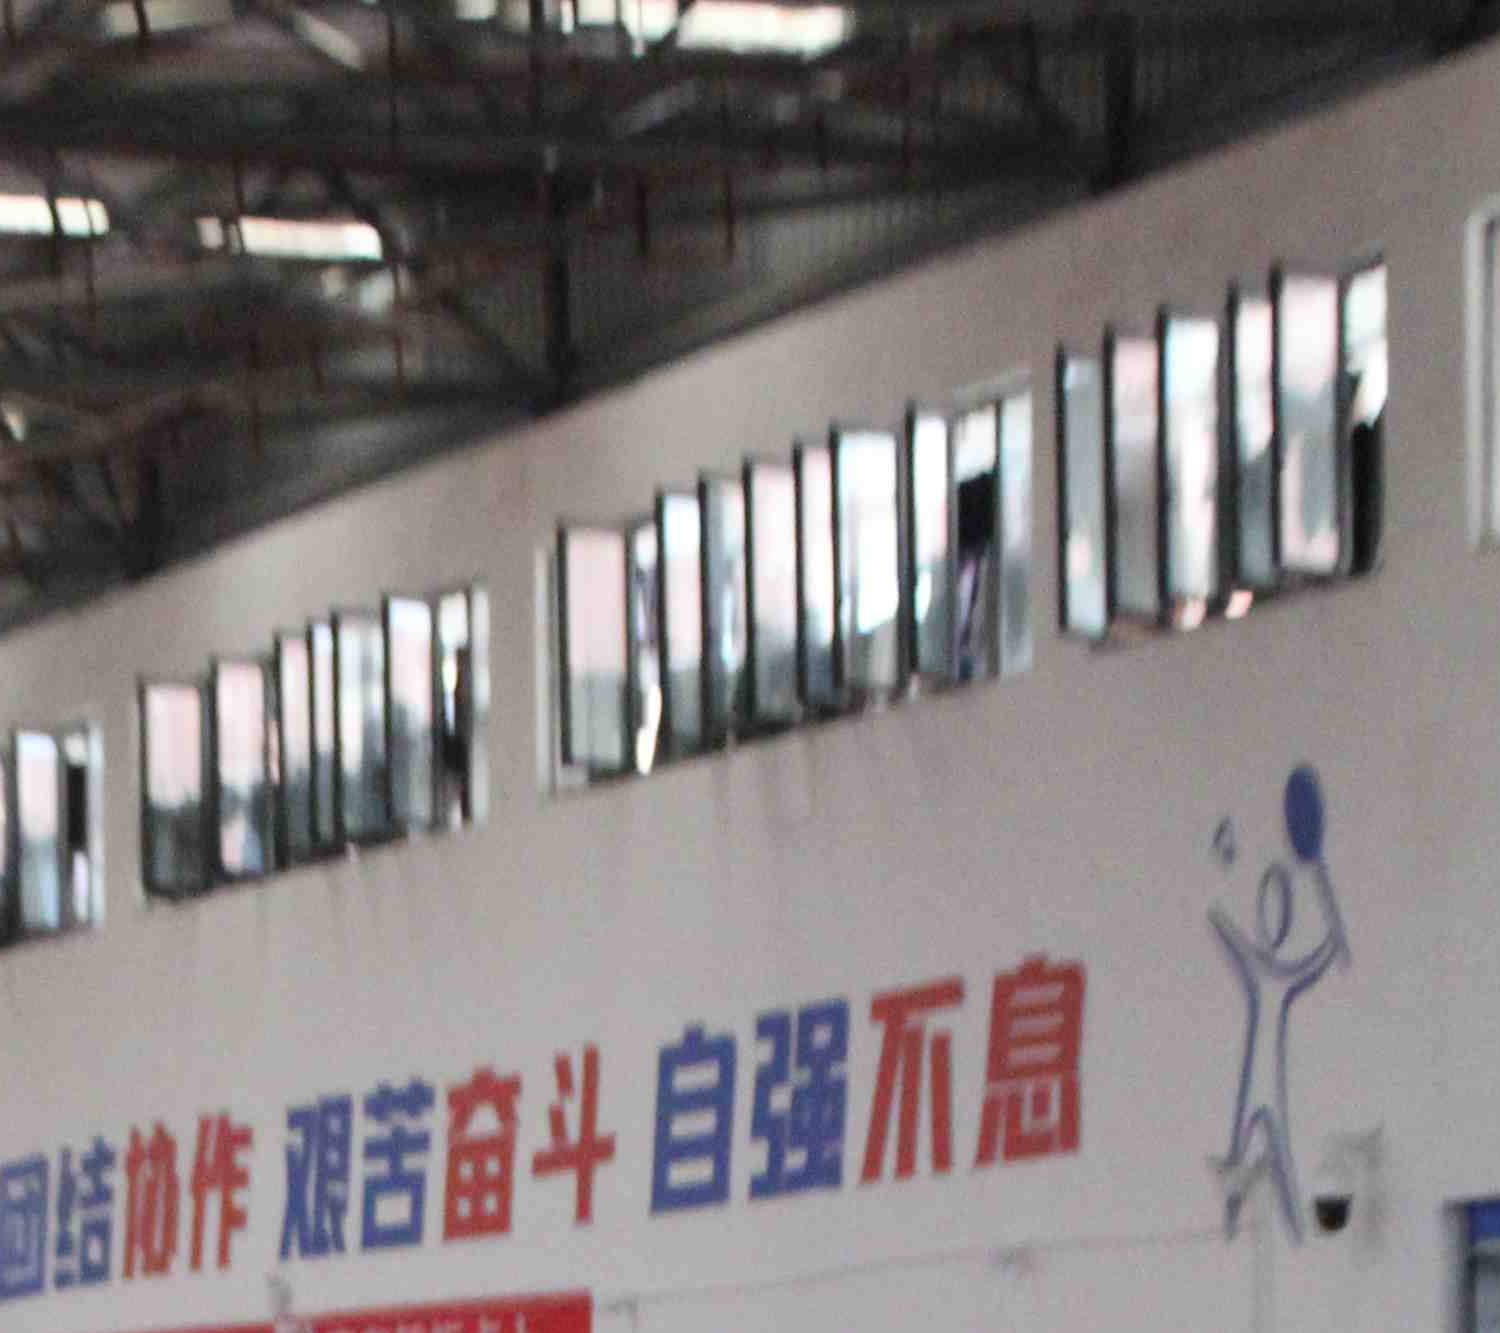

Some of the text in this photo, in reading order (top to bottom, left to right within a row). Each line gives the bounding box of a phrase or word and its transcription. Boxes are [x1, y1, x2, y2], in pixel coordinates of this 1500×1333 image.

[279, 1042, 616, 1262] 艰苦奋斗
[649, 953, 1088, 1217] 自强不息
